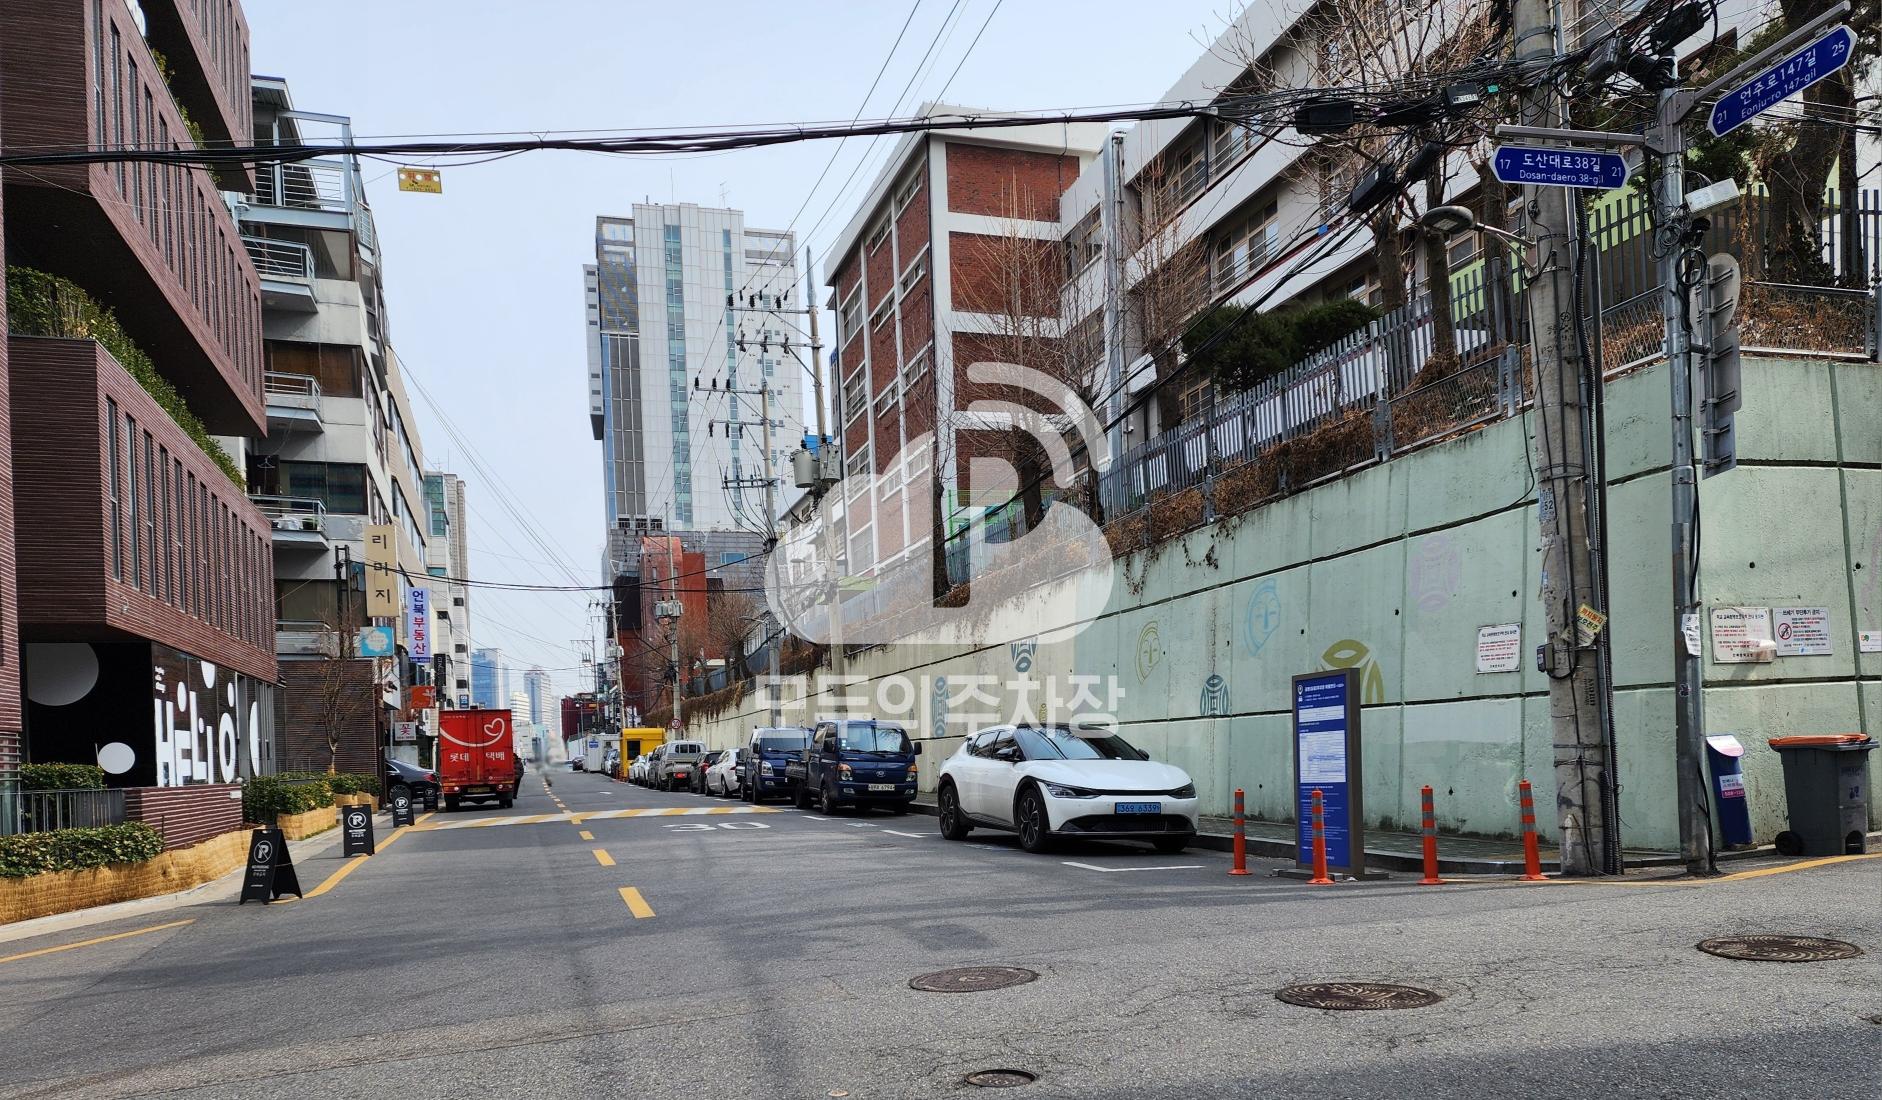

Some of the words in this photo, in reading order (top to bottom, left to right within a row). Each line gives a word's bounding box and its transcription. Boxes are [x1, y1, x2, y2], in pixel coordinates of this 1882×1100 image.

[1831, 41, 1845, 57] 25
[1740, 48, 1817, 105] 언주로147길
[1741, 91, 1782, 119] Eonju-ro
[1784, 67, 1817, 94] 147-gil
[1717, 110, 1728, 125] 21
[1500, 159, 1511, 170] 17
[1522, 153, 1601, 172] 도산대로38길
[1520, 169, 1577, 182] Dosan-daero
[1578, 173, 1604, 185] 38-gil
[1611, 166, 1623, 177] 21
[450, 752, 469, 762] 롯데
[485, 751, 505, 761] 택배
[661, 822, 771, 832] 30
